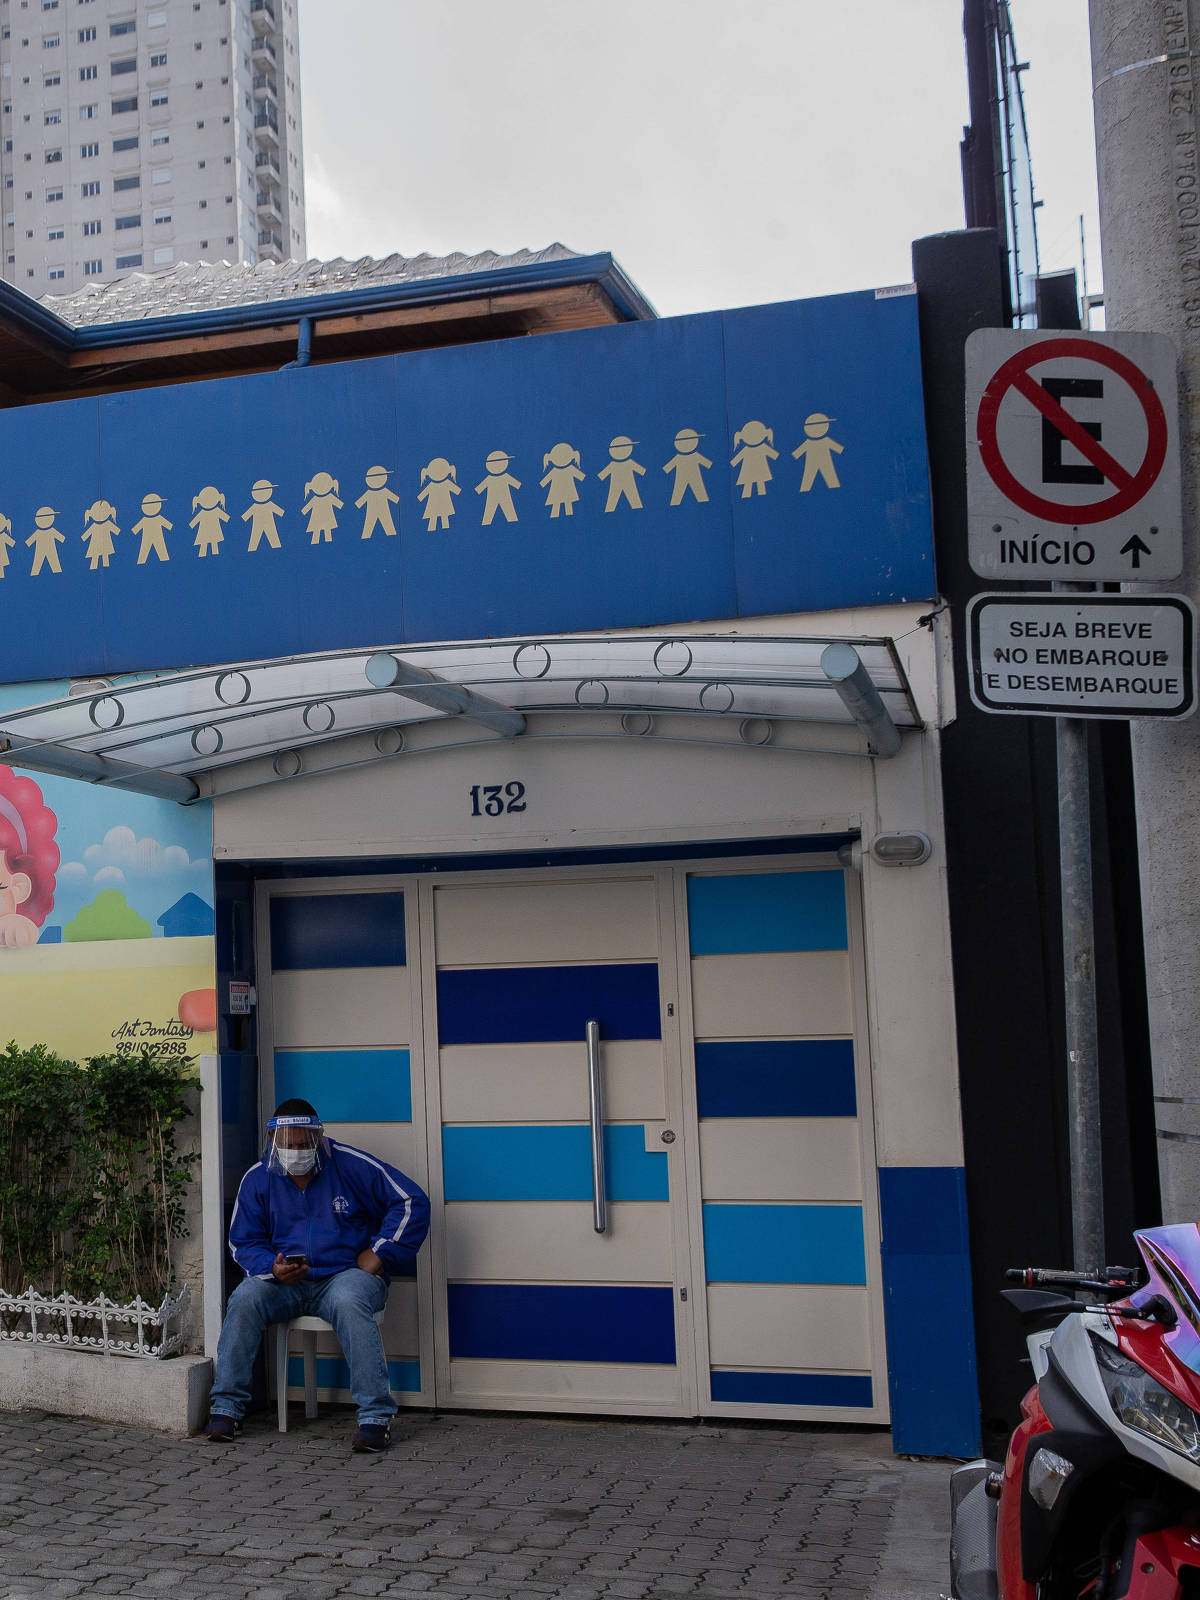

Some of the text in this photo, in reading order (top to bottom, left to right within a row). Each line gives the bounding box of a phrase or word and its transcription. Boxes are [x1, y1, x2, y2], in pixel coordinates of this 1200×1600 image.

[1000, 534, 1095, 566] INÍCIO
[1009, 621, 1152, 639] SEJA BREVE
[996, 648, 1168, 667] NO EMBARQUE
[987, 674, 1179, 695] E DESEMBARQUE
[469, 781, 527, 816] 132
[111, 1018, 193, 1040] Art Fantasy
